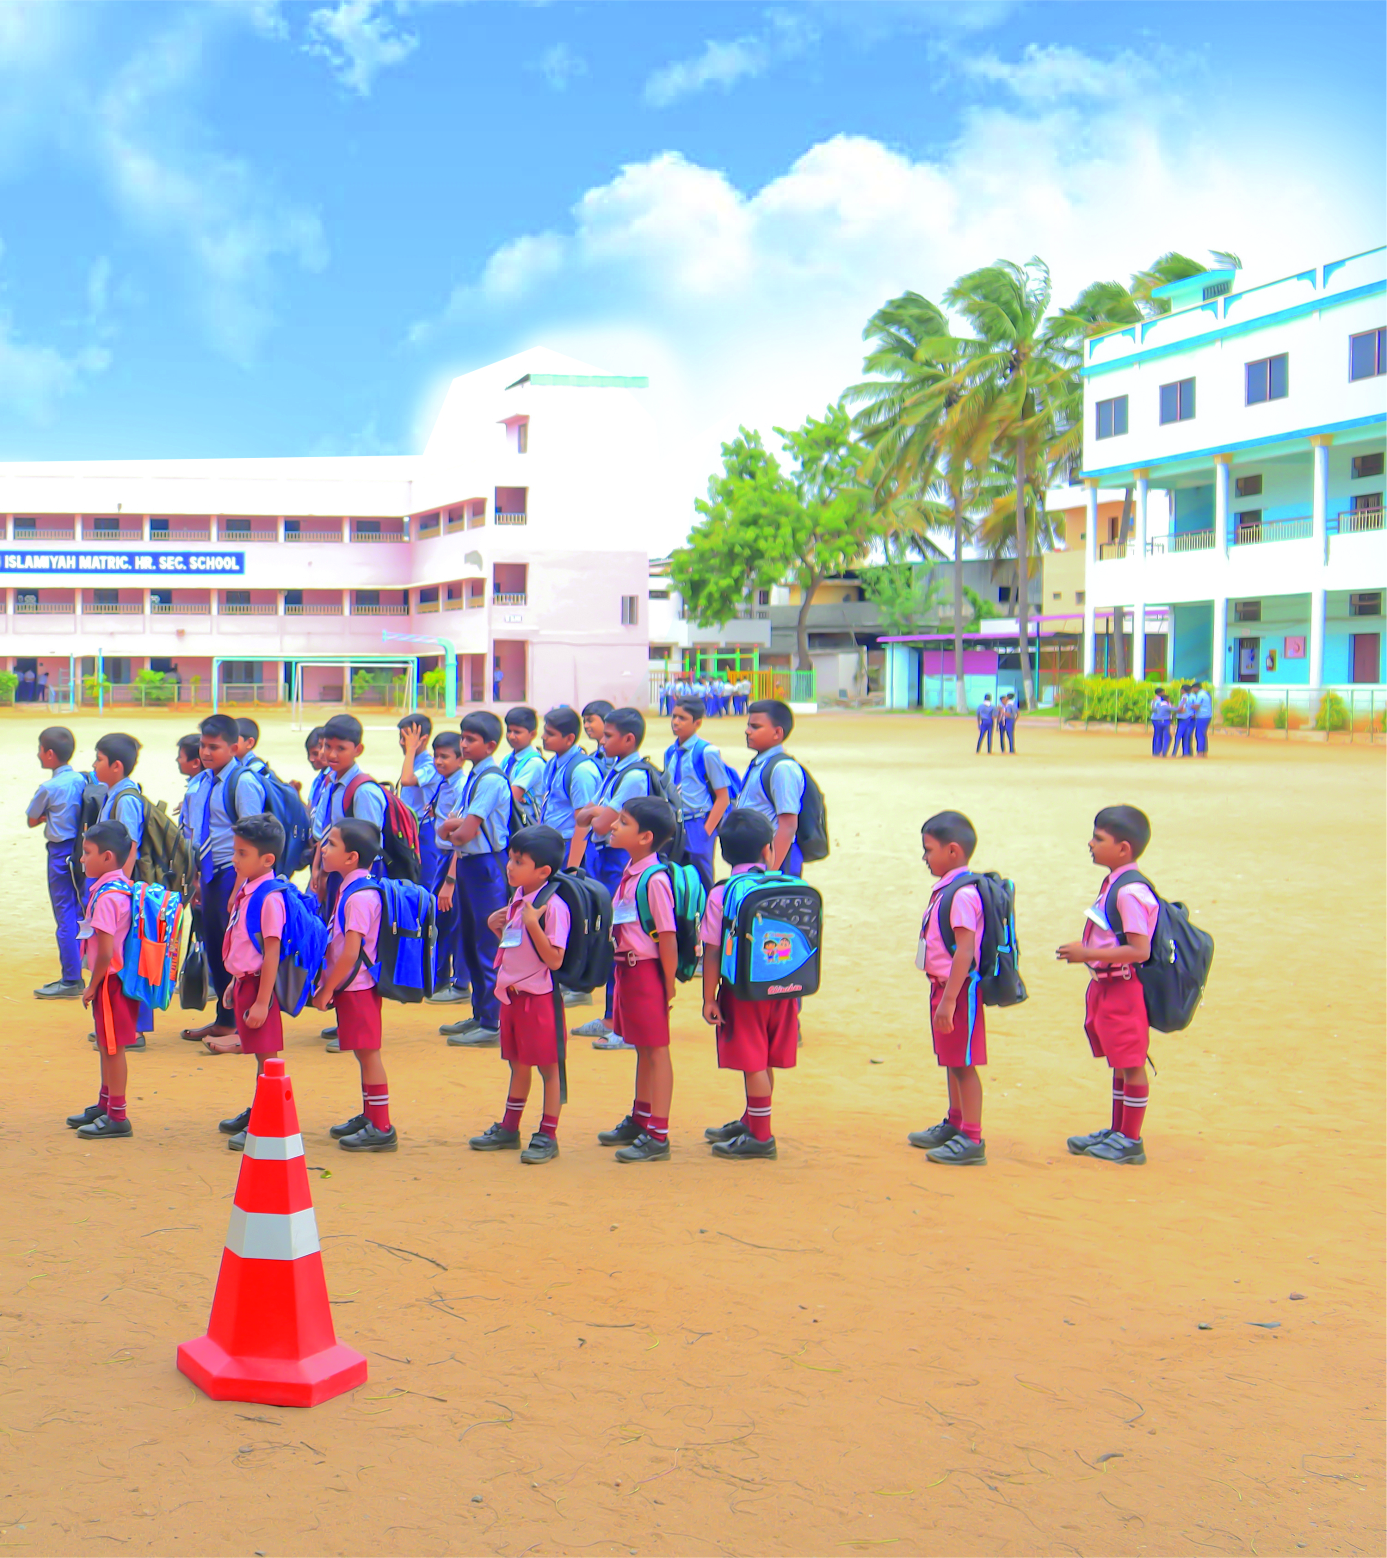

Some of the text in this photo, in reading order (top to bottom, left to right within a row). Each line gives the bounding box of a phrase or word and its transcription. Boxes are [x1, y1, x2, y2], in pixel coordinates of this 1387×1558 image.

[4, 554, 240, 570] ISLAMIYAH MATRIC. HR. SEC. SCHOOL
